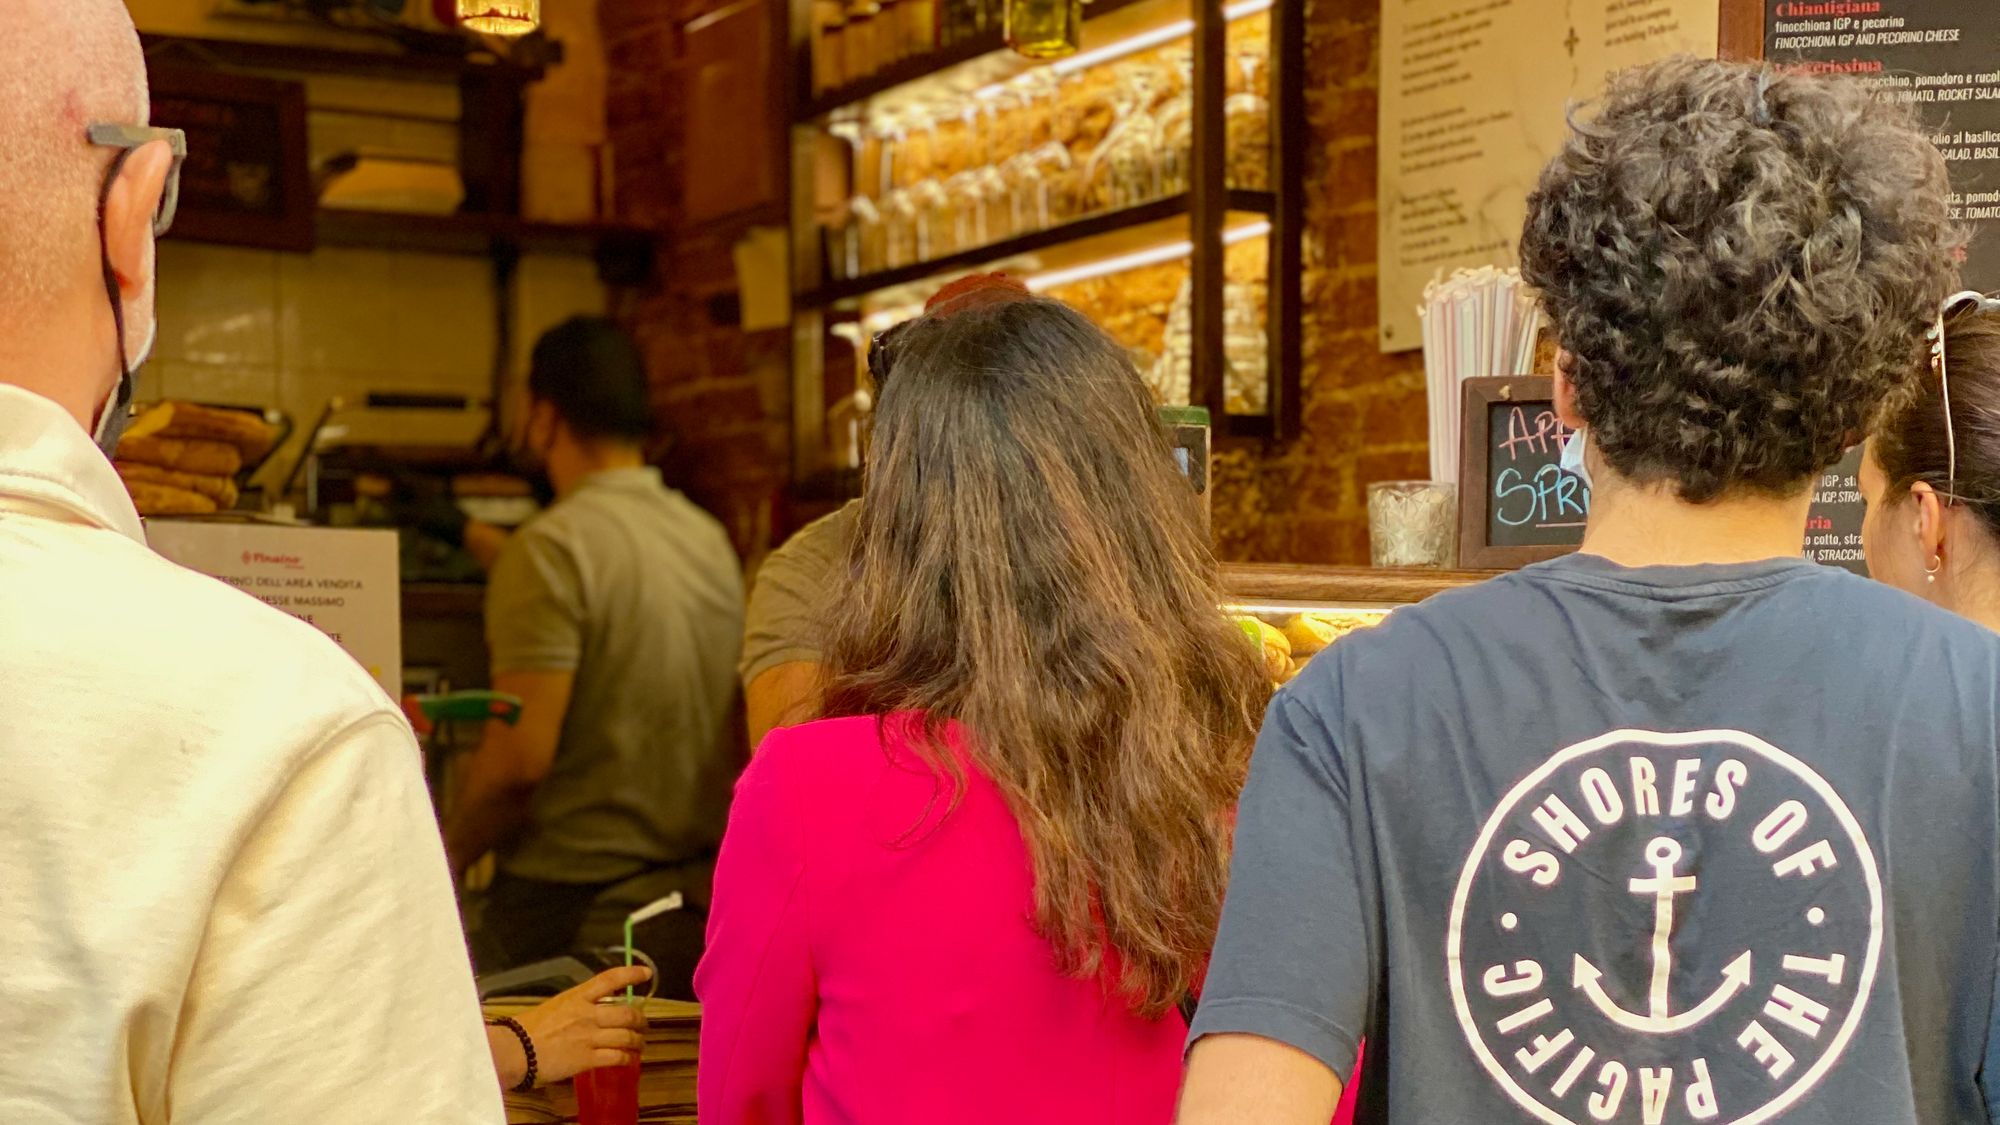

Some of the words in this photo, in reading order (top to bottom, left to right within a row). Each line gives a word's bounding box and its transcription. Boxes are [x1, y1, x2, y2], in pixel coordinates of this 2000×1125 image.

[1775, 0, 1881, 17] Chiantigiana
[1775, 20, 1831, 33] finocchiona
[1834, 17, 1851, 30] IGP
[1854, 20, 1860, 30] e
[1862, 16, 1905, 31] pecorino
[1775, 34, 1836, 49] FINOCCHIONA
[1838, 33, 1855, 47] IGP
[1856, 32, 1876, 46] AND
[1876, 30, 1924, 45] PECORINO
[1925, 28, 1960, 42] CHEESE
[1915, 72, 1964, 88] pomodoro
[1966, 73, 1973, 84] e
[1937, 87, 1974, 101] ROCKET
[1933, 131, 1951, 145] olio
[1953, 131, 1963, 144] al
[1966, 189, 2000, 206] pomod
[1807, 515, 1832, 530] ria
[1813, 533, 1842, 546] cotto,
[256, 576, 313, 589] DELL'AREA
[317, 578, 363, 590] VENDITA
[293, 595, 345, 608] MASSIMO
[1502, 756, 1748, 886] SHORES
[1752, 800, 1838, 878] OF
[1736, 953, 1846, 1081] THE
[1483, 958, 1718, 1125] PACIFIC
